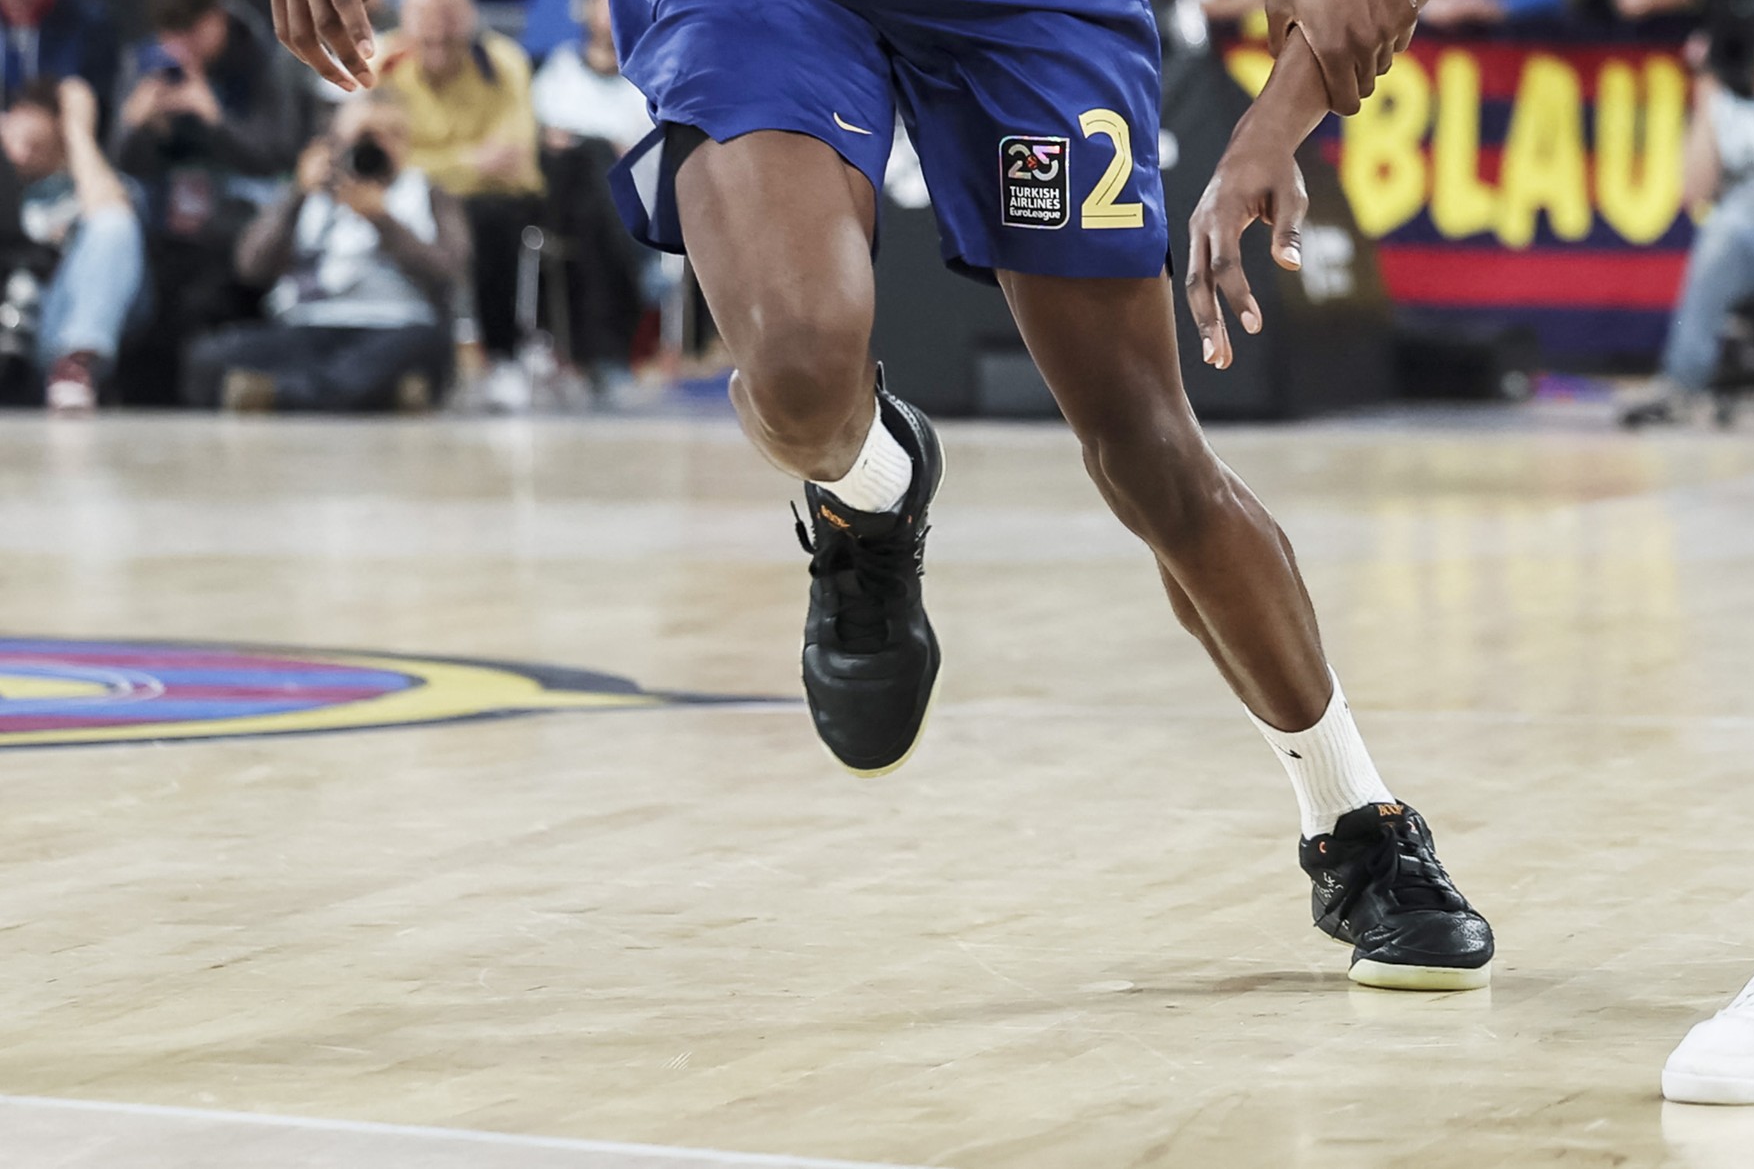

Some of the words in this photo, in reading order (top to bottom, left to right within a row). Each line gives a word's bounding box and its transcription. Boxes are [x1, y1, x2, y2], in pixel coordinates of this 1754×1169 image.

[1007, 143, 1063, 182] 25
[1078, 108, 1145, 229] 2
[1009, 186, 1060, 198] TURKISH
[1009, 197, 1061, 210] AIRLINES
[1009, 209, 1061, 222] EuroLeague
